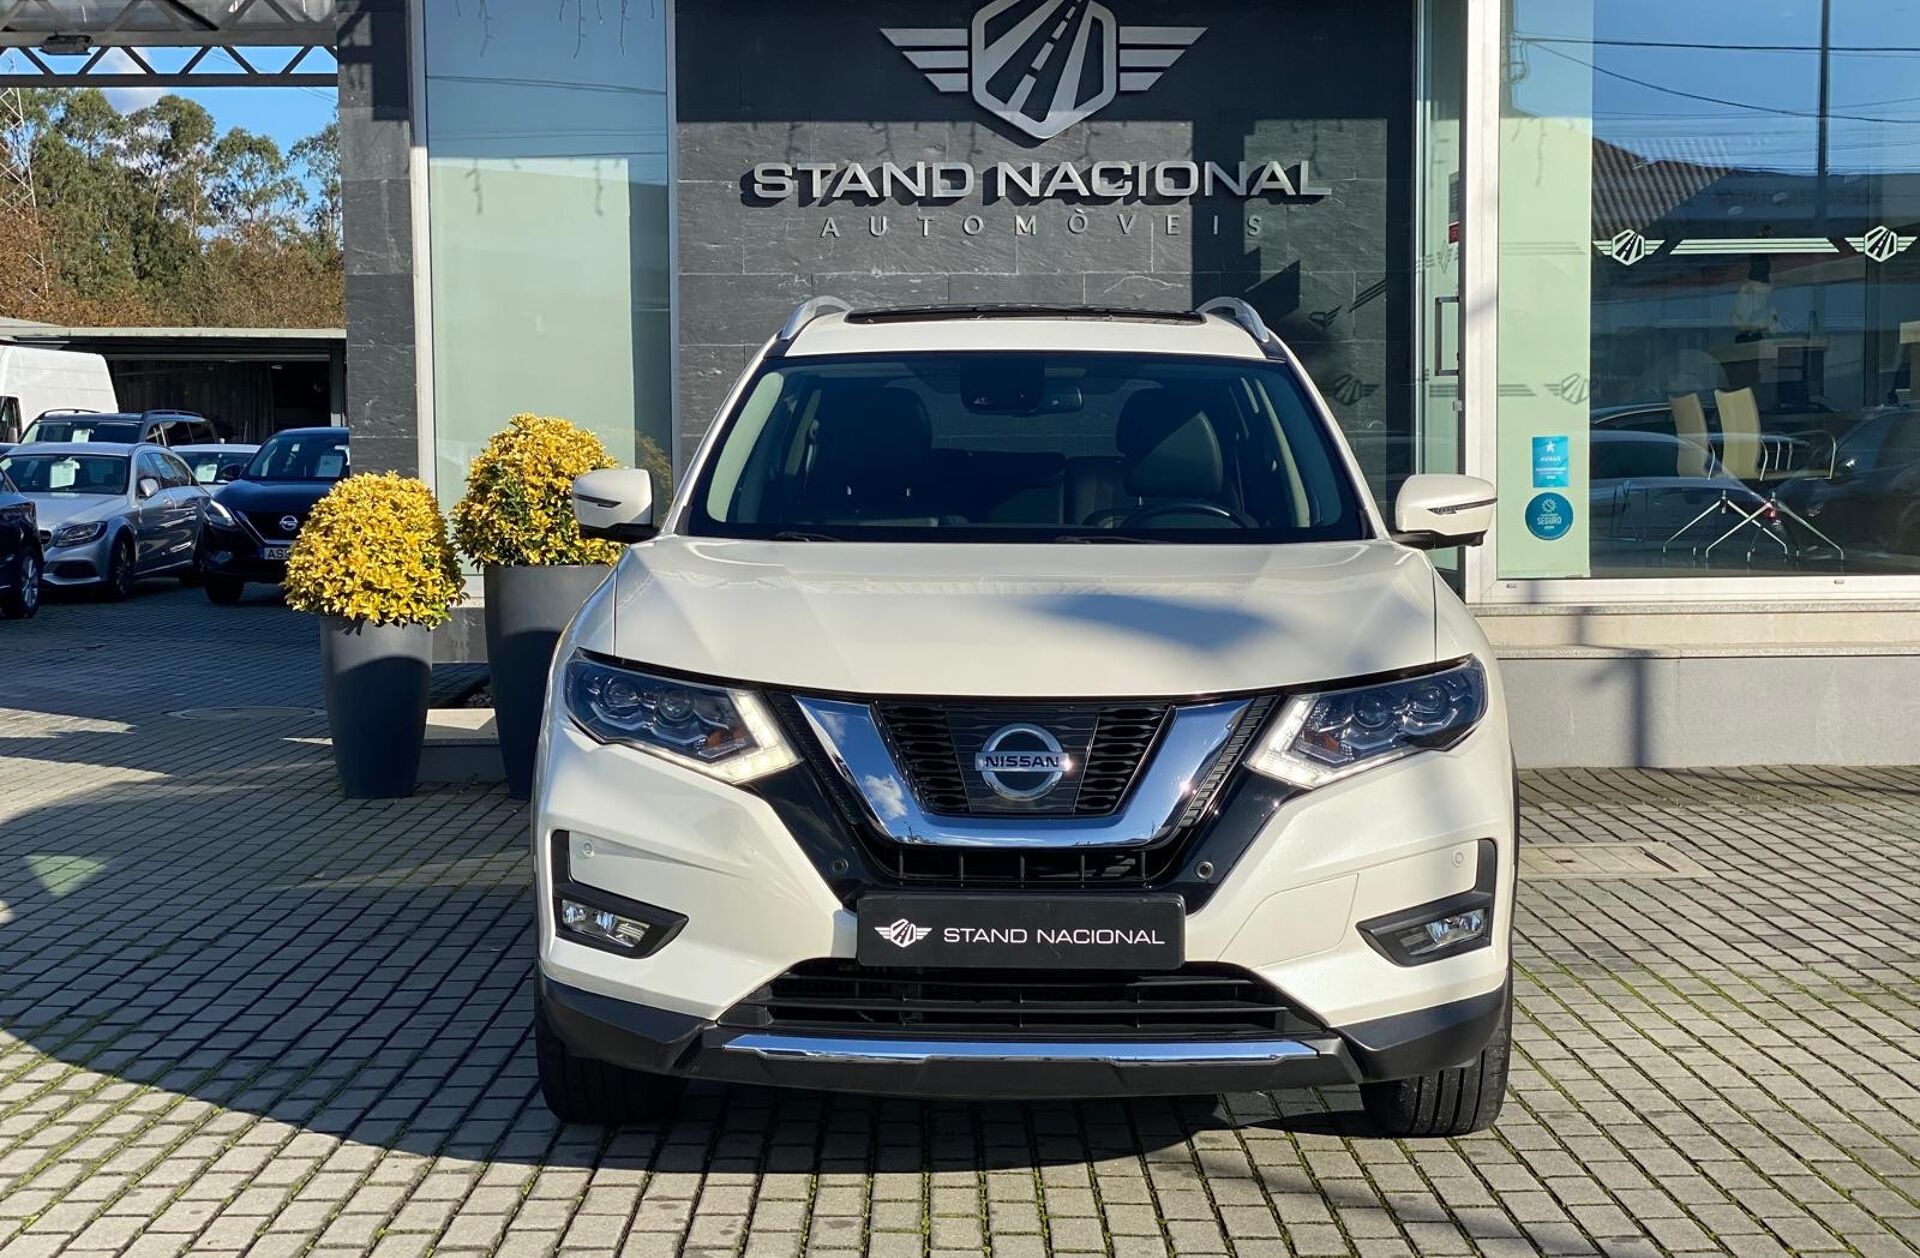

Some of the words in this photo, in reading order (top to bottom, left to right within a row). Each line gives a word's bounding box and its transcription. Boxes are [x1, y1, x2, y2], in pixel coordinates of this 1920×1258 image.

[754, 161, 974, 198] STAND
[997, 160, 1332, 197] NACIONAL
[984, 755, 1060, 768] NISSAN
[943, 927, 1028, 944] STAND
[1037, 929, 1165, 945] NACIONAL
